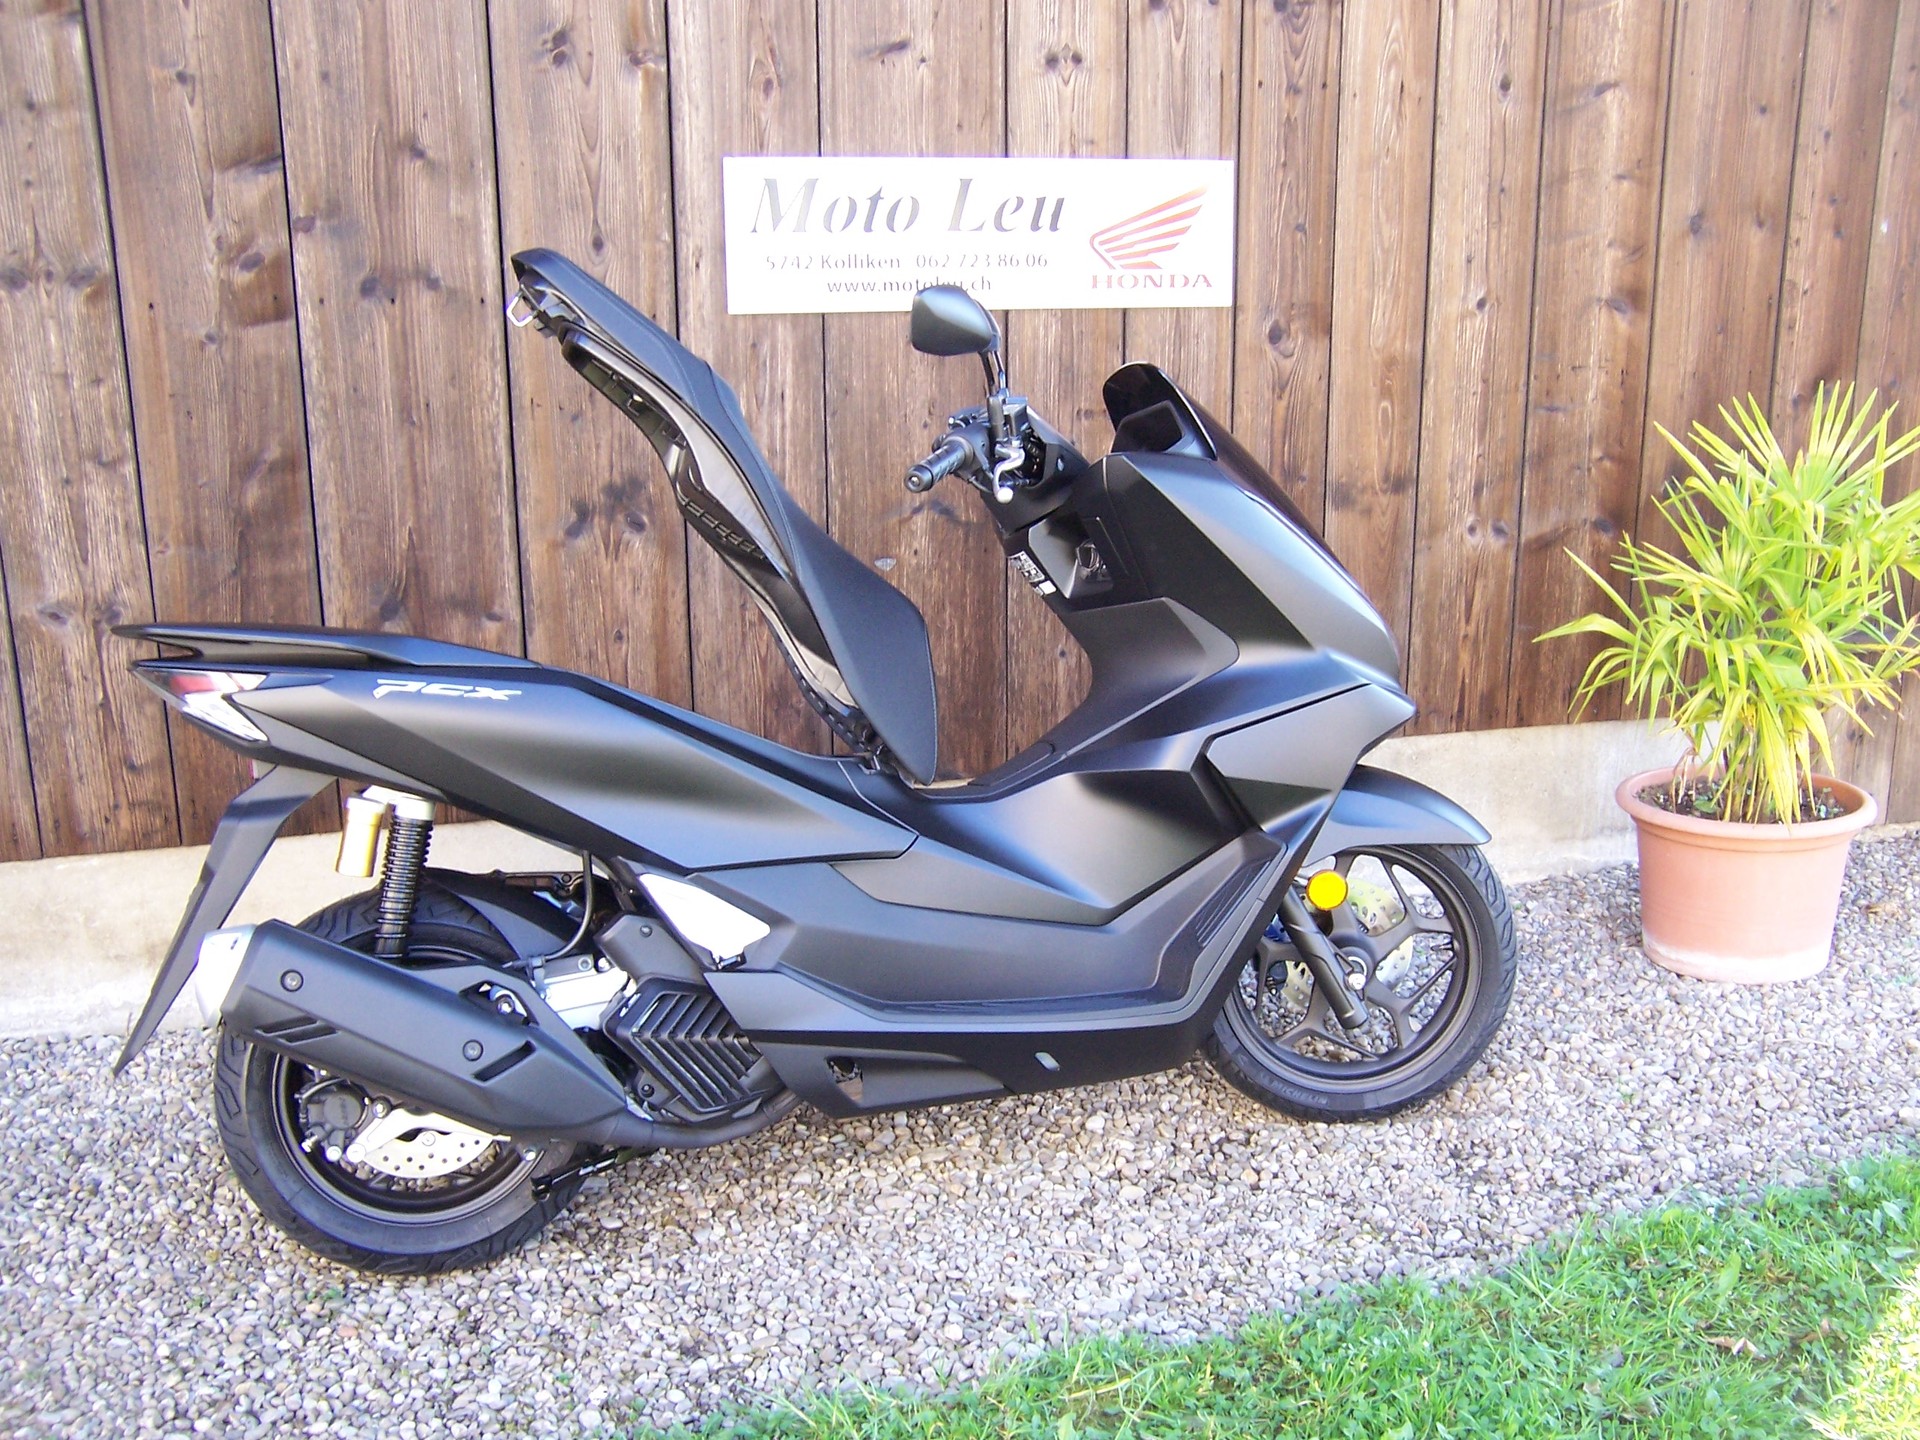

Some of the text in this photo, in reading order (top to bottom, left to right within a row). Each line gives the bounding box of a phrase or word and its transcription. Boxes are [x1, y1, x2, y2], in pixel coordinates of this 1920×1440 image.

[750, 178, 1065, 233] Moto Leu
[916, 254, 950, 268] 062
[959, 254, 990, 268] 723
[997, 254, 1020, 268] 86
[1025, 253, 1048, 268] 06
[1091, 274, 1213, 289] HONDA
[372, 678, 523, 701] PCX
